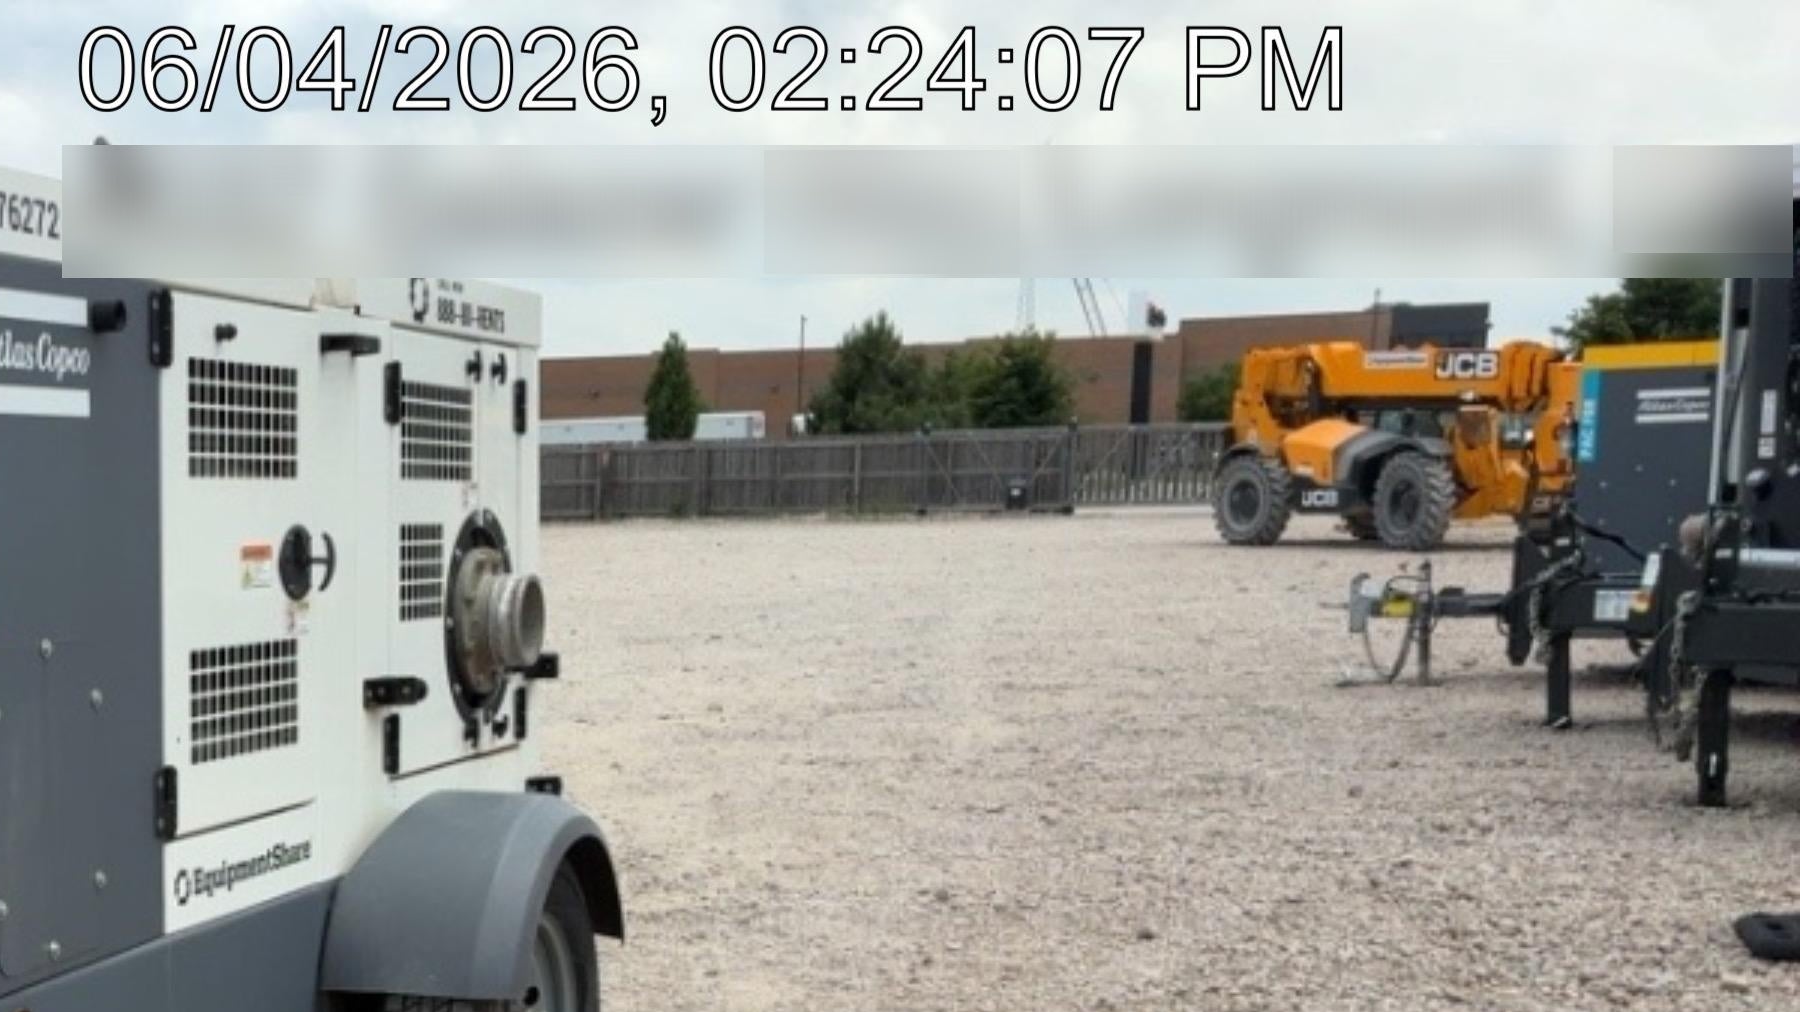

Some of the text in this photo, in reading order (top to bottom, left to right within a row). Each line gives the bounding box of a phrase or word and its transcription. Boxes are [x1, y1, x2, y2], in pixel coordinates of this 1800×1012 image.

[37, 332, 91, 381] Copco
[1435, 352, 1499, 379] JCB
[1301, 490, 1339, 508] JCB
[193, 839, 311, 897] EquipmentShare
